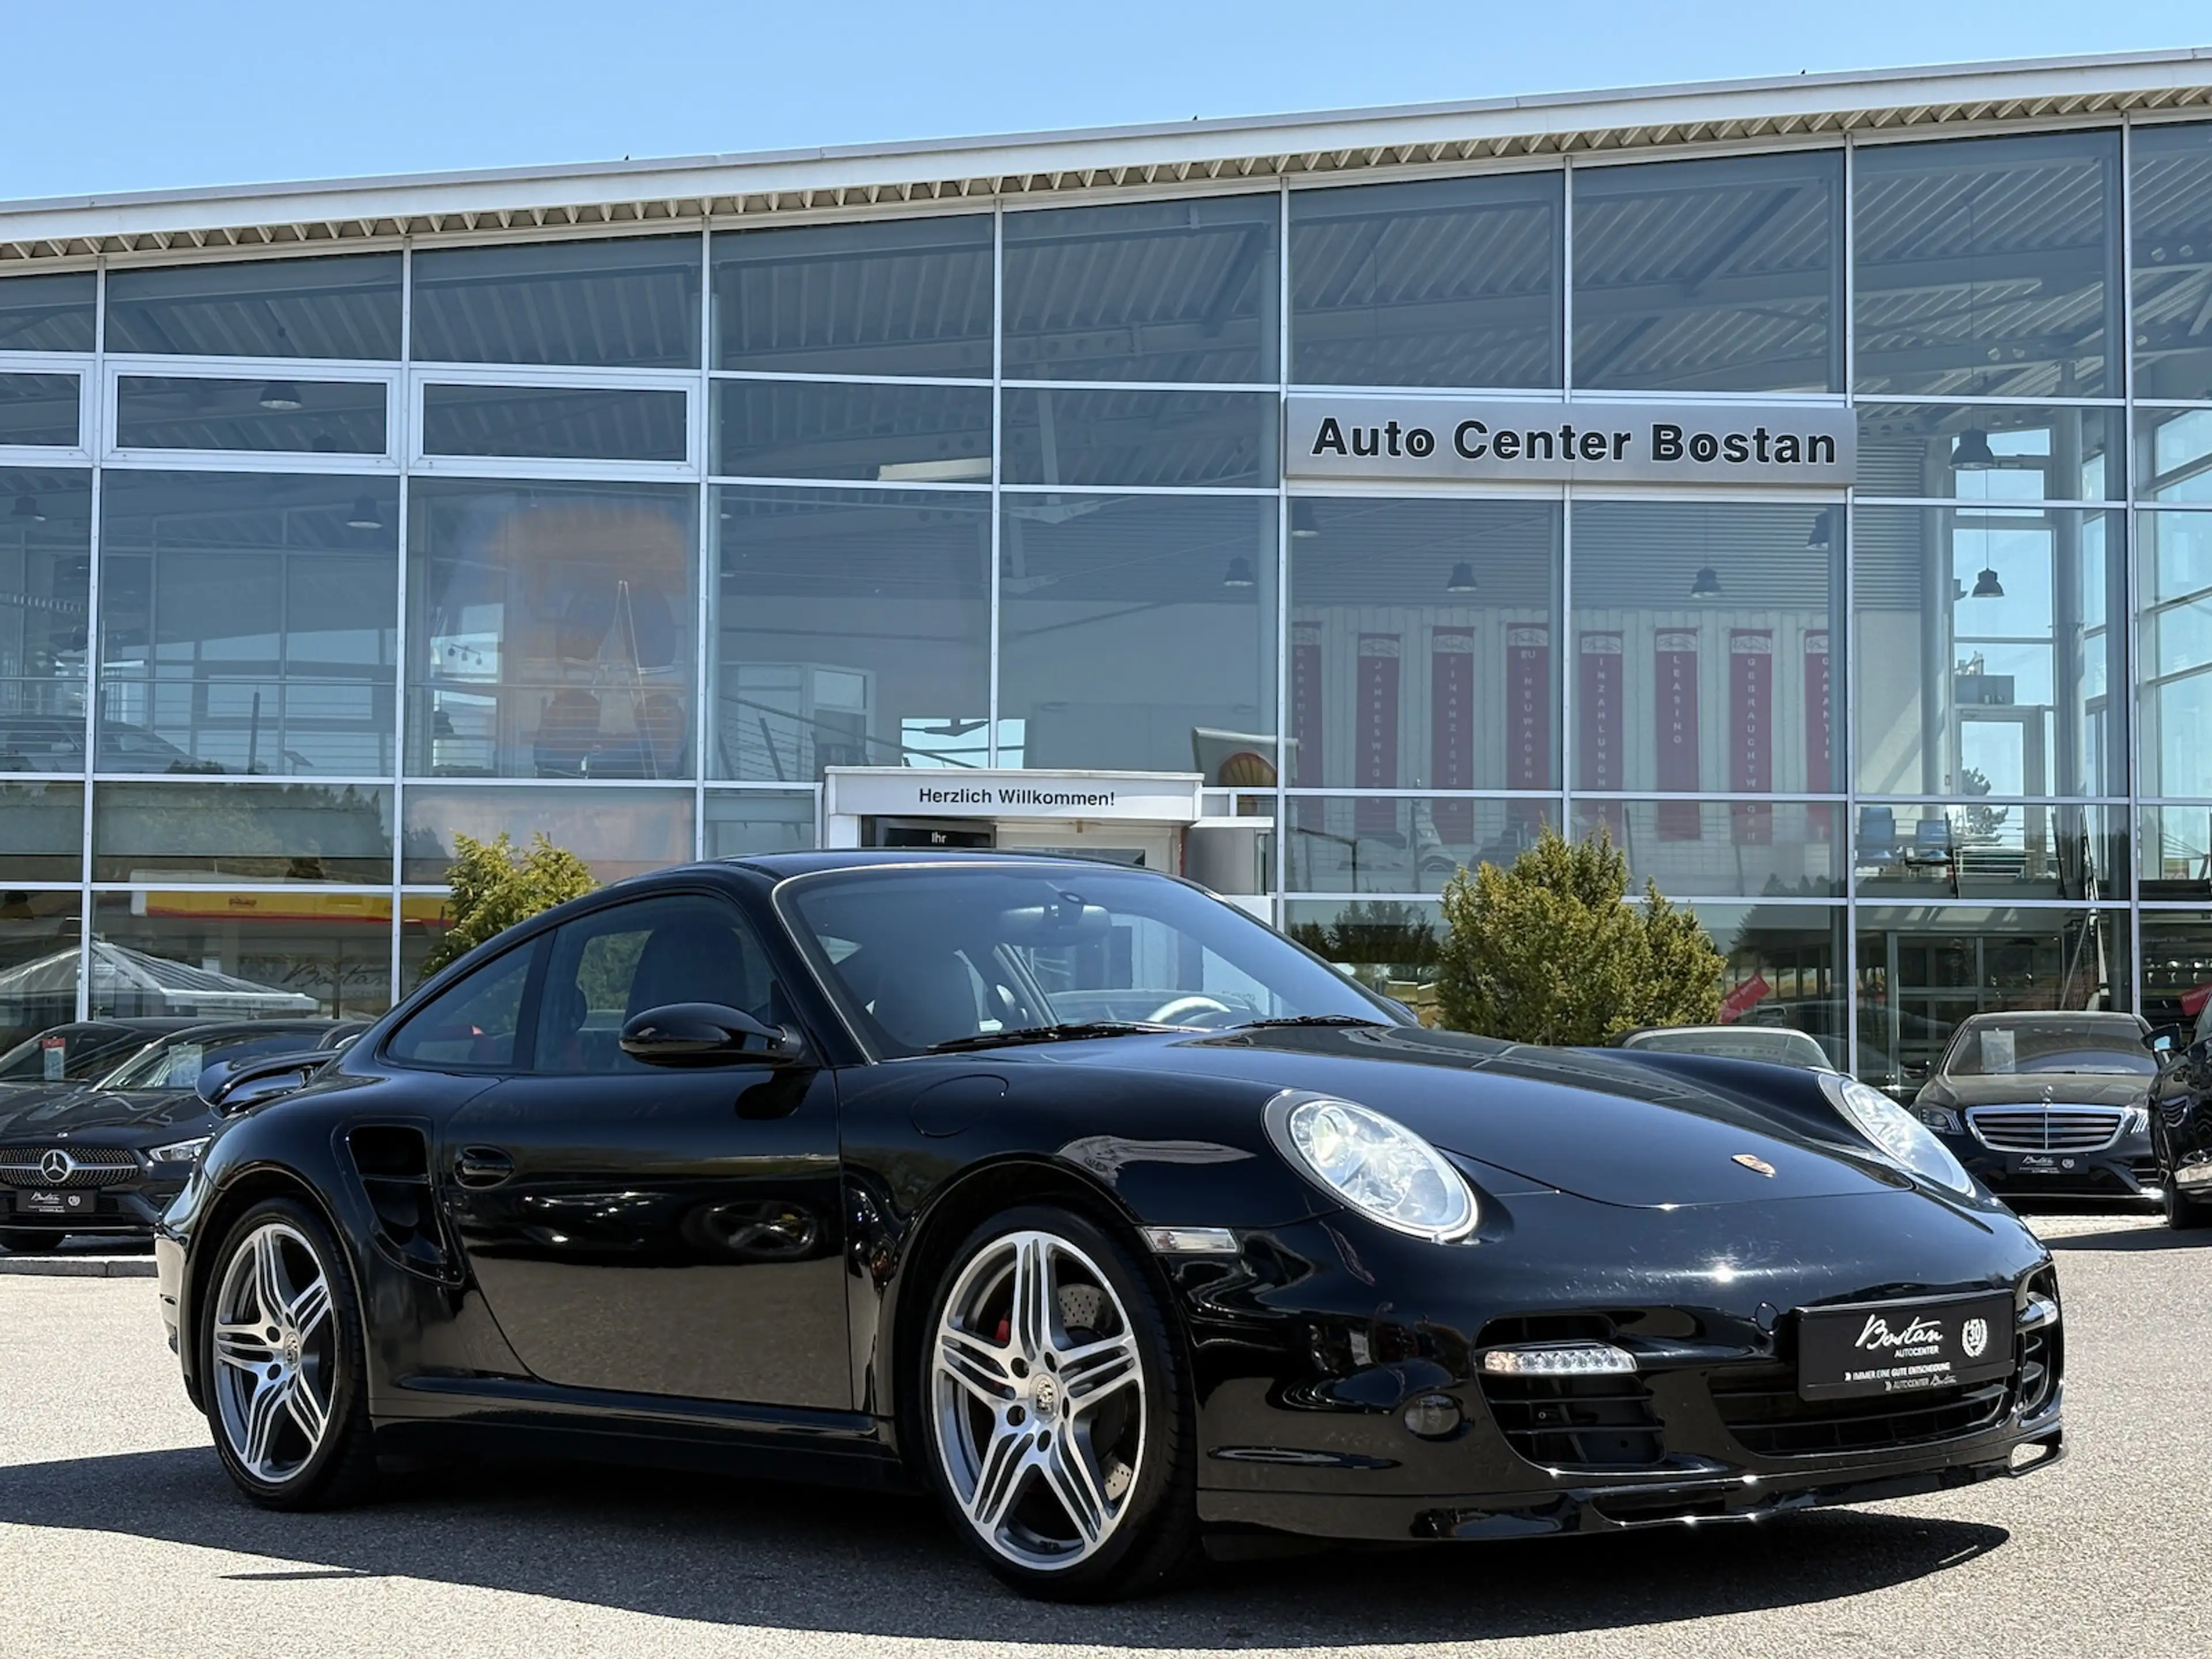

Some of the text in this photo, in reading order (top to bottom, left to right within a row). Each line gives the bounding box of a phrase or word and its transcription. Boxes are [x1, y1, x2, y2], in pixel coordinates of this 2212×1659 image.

[1311, 417, 1836, 465] Auto Center Bostan
[1673, 655, 1682, 744] LEASING
[1448, 657, 1457, 811] FINANZIERUG
[1746, 658, 1756, 841] GEBRAUCHTWGEN
[919, 788, 1115, 806] Herzlich Willkommen!
[931, 831, 947, 843] Ihr
[1855, 1313, 1943, 1350] Bostan
[1894, 1345, 1940, 1358] AUTOCENTER
[1853, 1370, 1876, 1380] IMMER
[1876, 1369, 1891, 1378] EINE
[1891, 1367, 1907, 1377] GUTE
